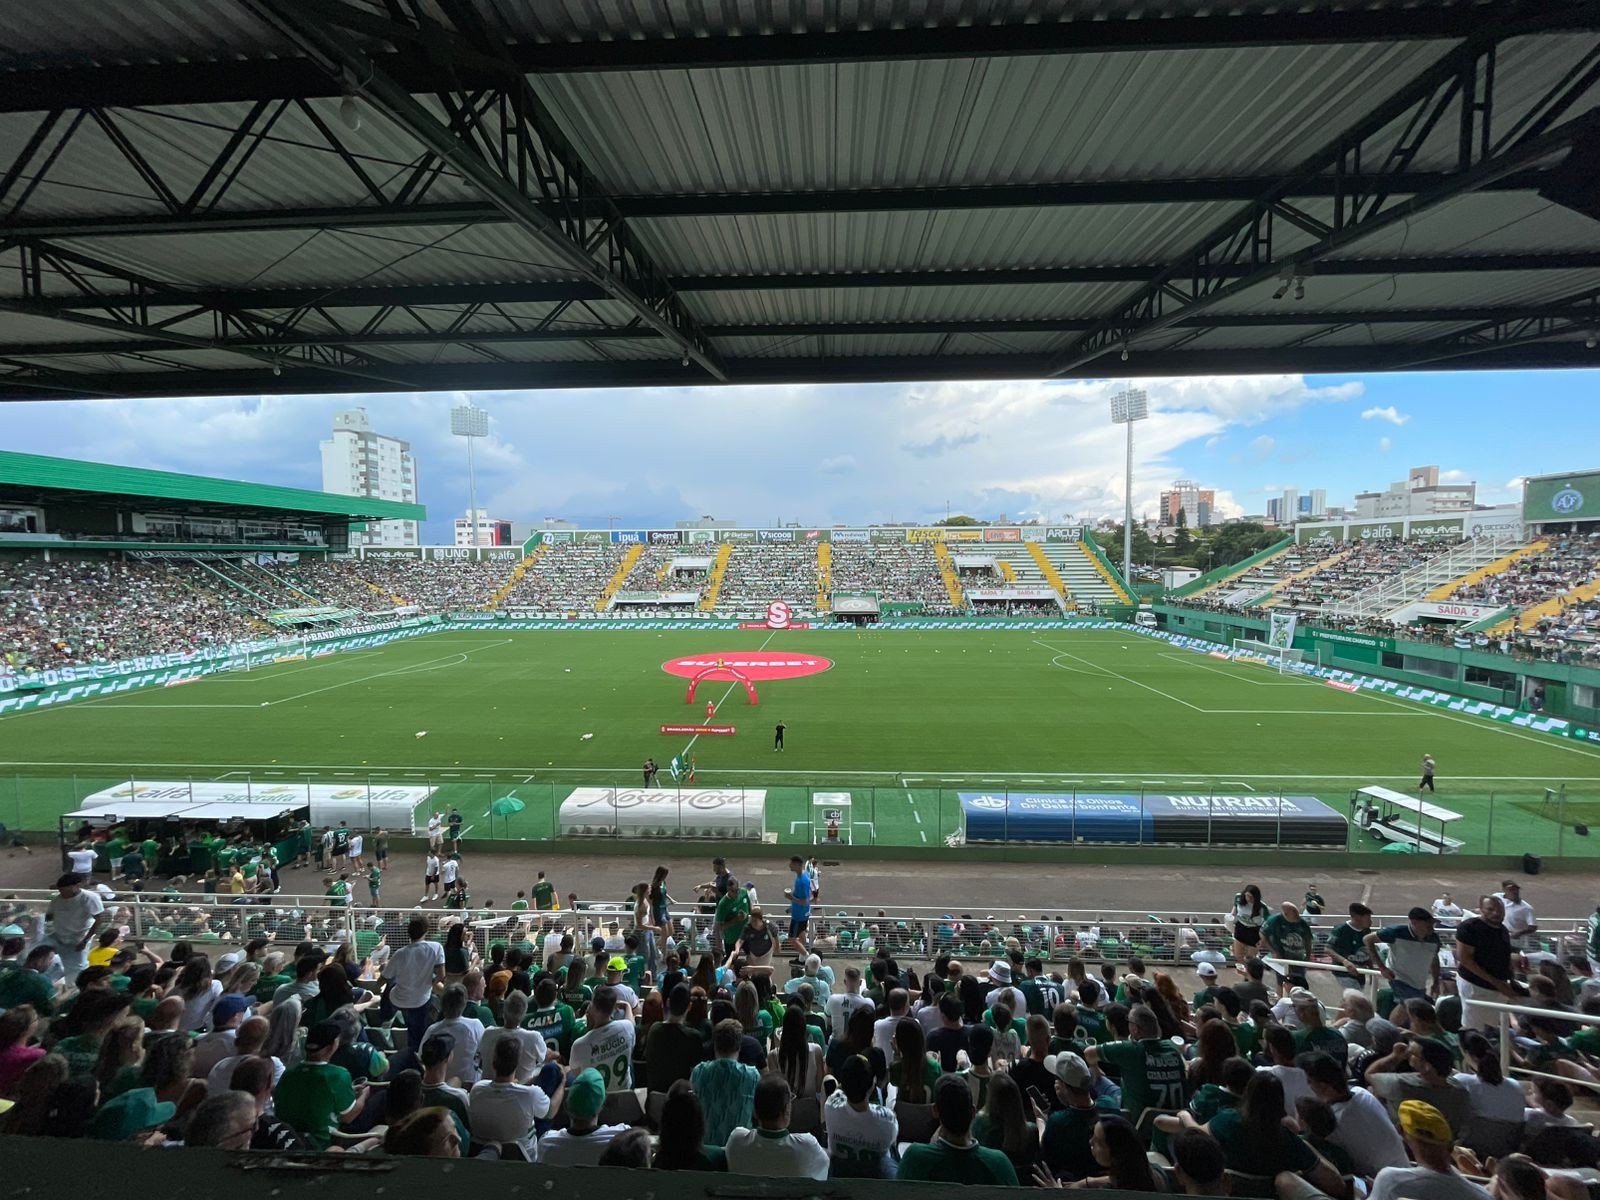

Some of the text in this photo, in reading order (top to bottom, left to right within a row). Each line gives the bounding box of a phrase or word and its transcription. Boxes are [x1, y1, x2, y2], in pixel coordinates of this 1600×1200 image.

[618, 531, 639, 542] ipuá
[767, 531, 792, 539] SICOOB
[910, 529, 942, 539] Tasca
[1047, 528, 1081, 538] ARCUS
[1372, 526, 1392, 538] alfa
[444, 549, 470, 559] UNO
[498, 550, 515, 560] alfa
[1472, 608, 1480, 617] 2
[137, 786, 191, 799] alfa
[357, 789, 410, 801] alfa
[1166, 796, 1297, 807] NUTRATA
[1039, 987, 1060, 1009] 10
[527, 1012, 562, 1028] CAIXA
